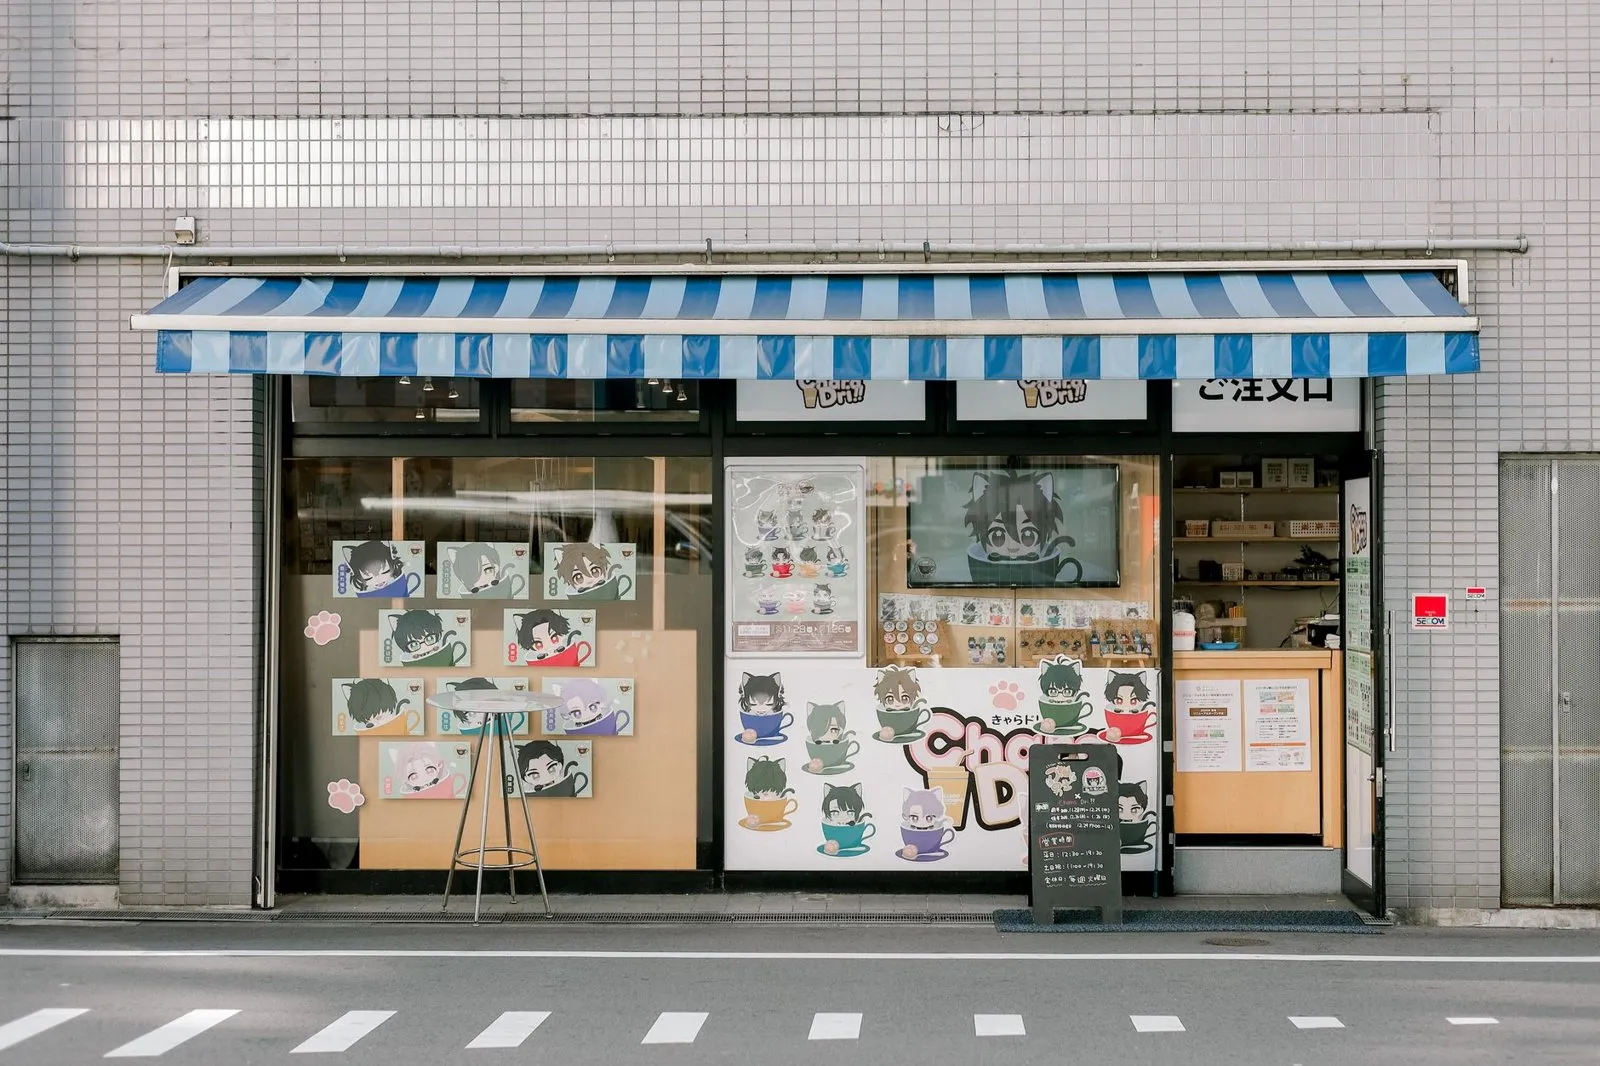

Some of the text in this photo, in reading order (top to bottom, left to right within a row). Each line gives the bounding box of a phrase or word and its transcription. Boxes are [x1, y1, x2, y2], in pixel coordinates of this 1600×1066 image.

[1416, 617, 1445, 625] SECOM
[992, 714, 1039, 726] きゃらド
